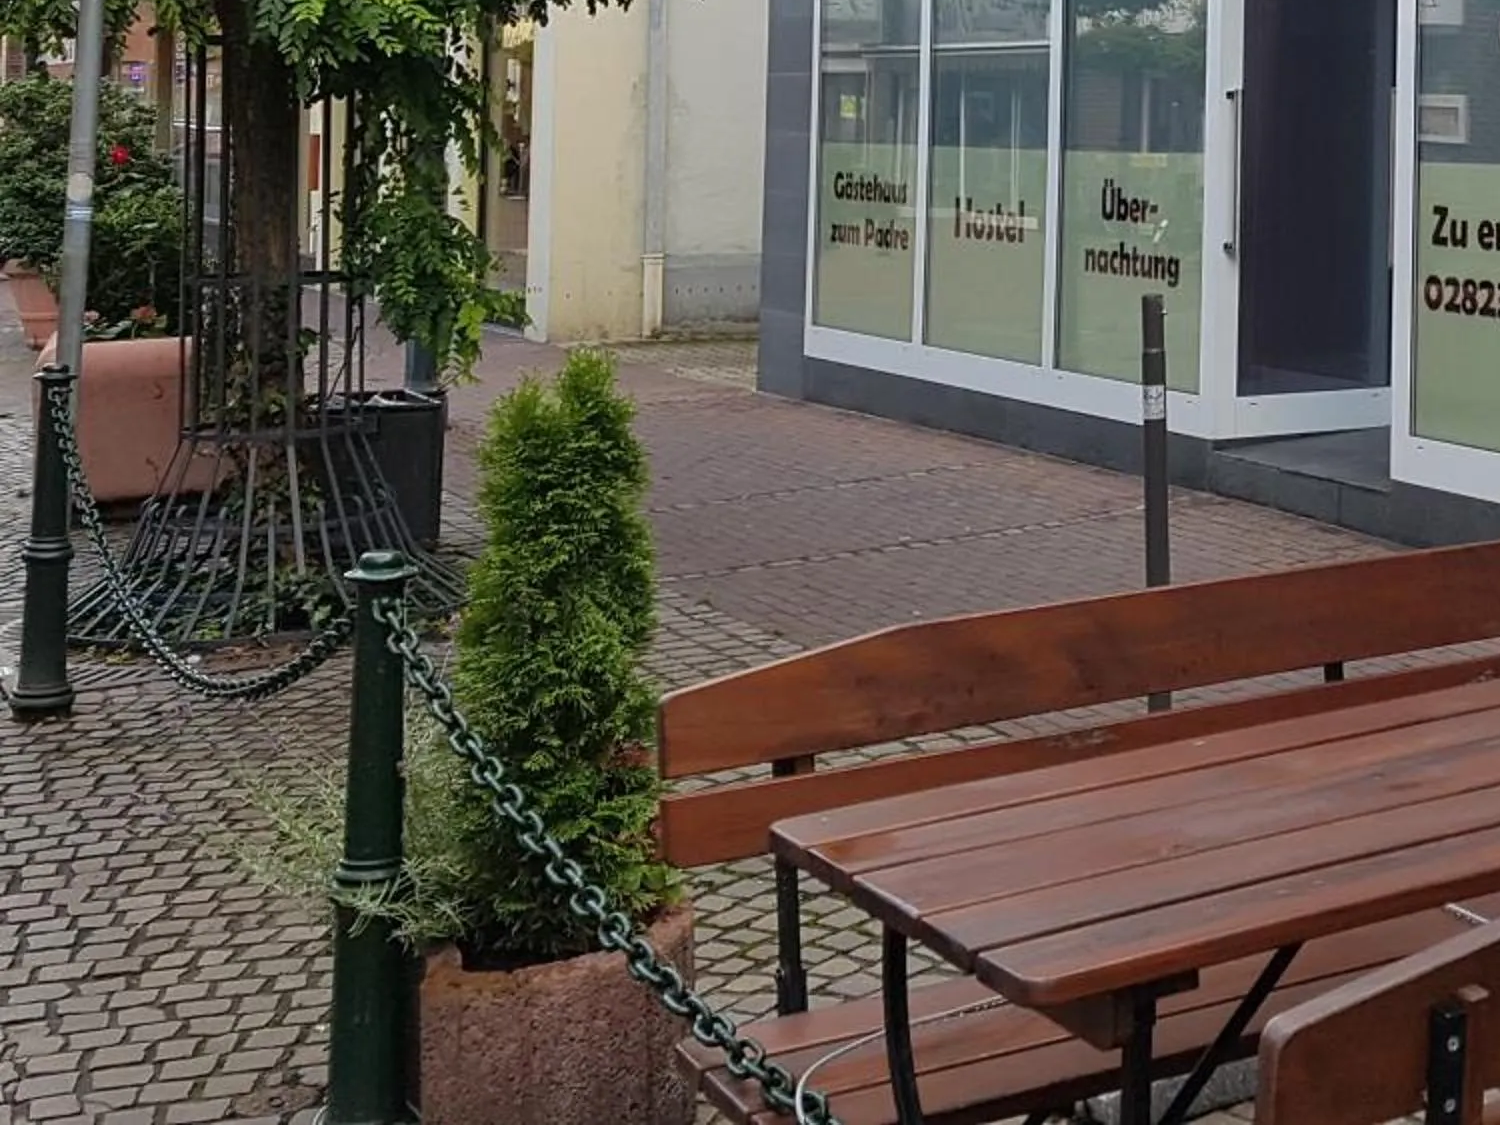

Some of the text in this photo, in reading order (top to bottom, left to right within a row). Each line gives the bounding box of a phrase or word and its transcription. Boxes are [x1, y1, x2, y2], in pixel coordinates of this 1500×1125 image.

[832, 171, 908, 205] Gästehaus
[1101, 178, 1159, 224] Über-
[829, 218, 909, 251] zum Padre
[1431, 205, 1469, 250] Zu
[1084, 242, 1181, 288] nachtung
